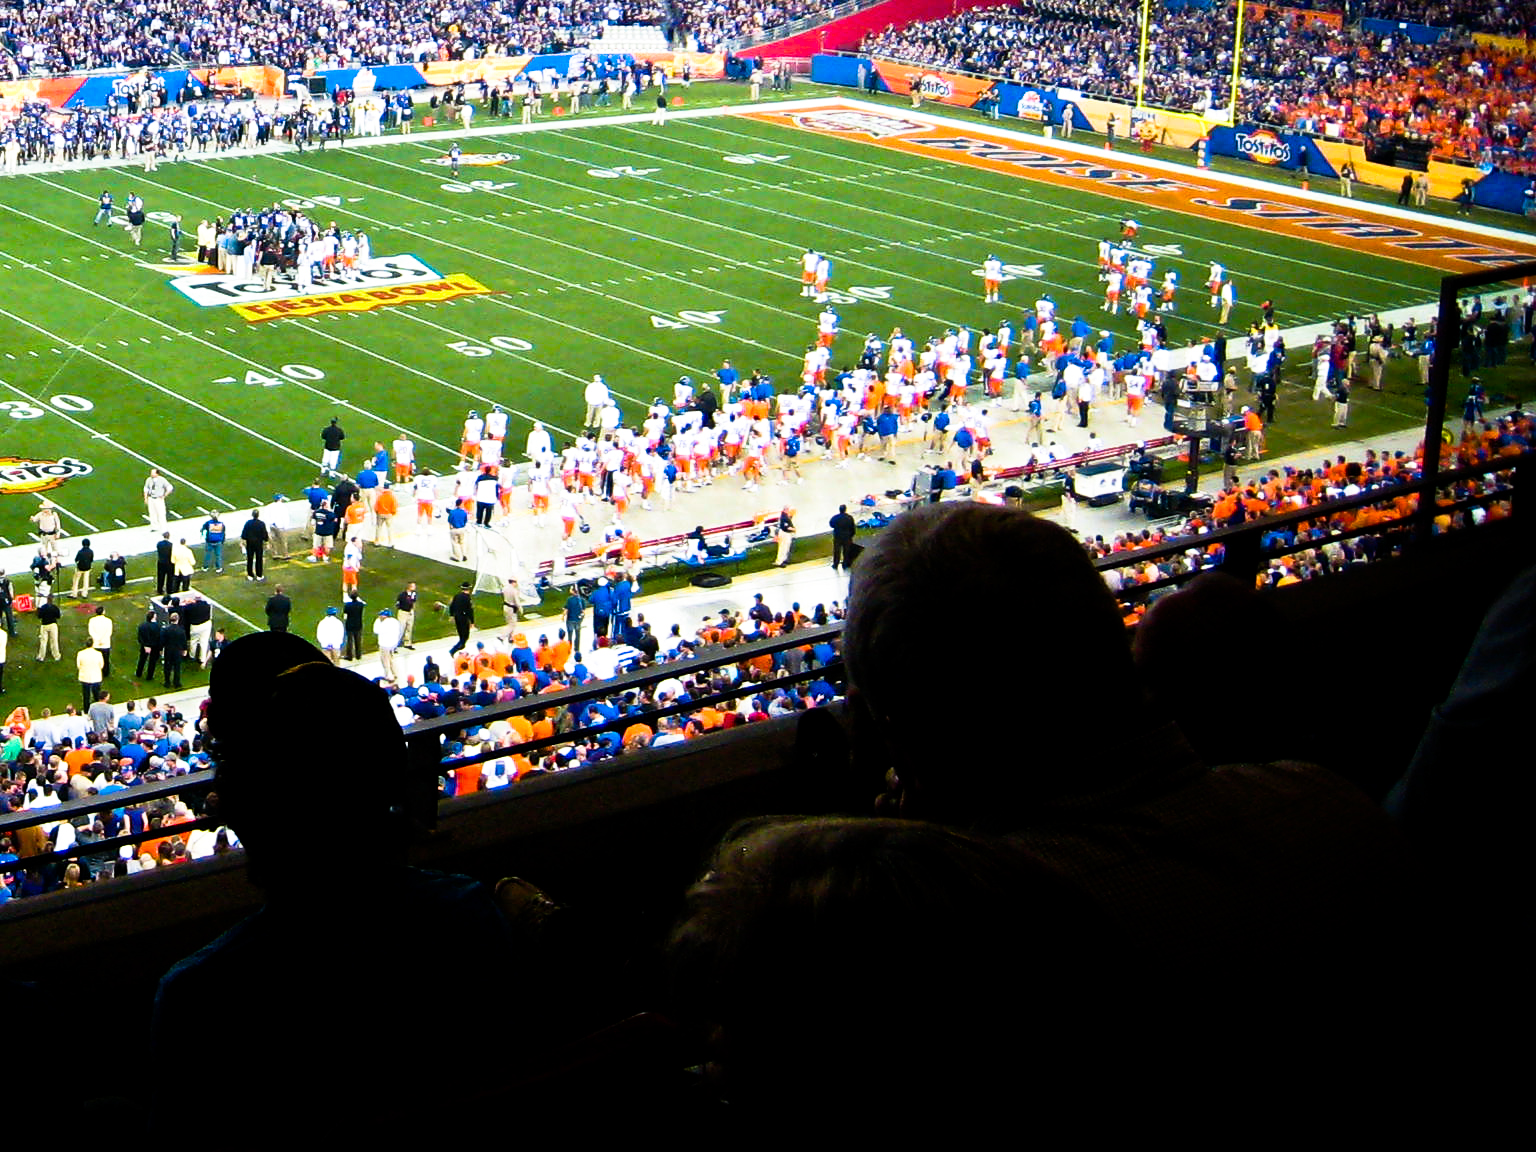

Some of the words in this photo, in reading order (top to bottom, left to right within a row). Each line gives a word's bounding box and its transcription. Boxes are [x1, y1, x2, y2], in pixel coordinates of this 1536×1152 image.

[898, 137, 1218, 193] BOISE
[245, 293, 364, 316] FIESTA
[367, 281, 481, 302] BOWL
[651, 310, 721, 329] 40
[447, 335, 533, 358] 50
[244, 363, 326, 387] 40
[18, 596, 31, 609] 20
